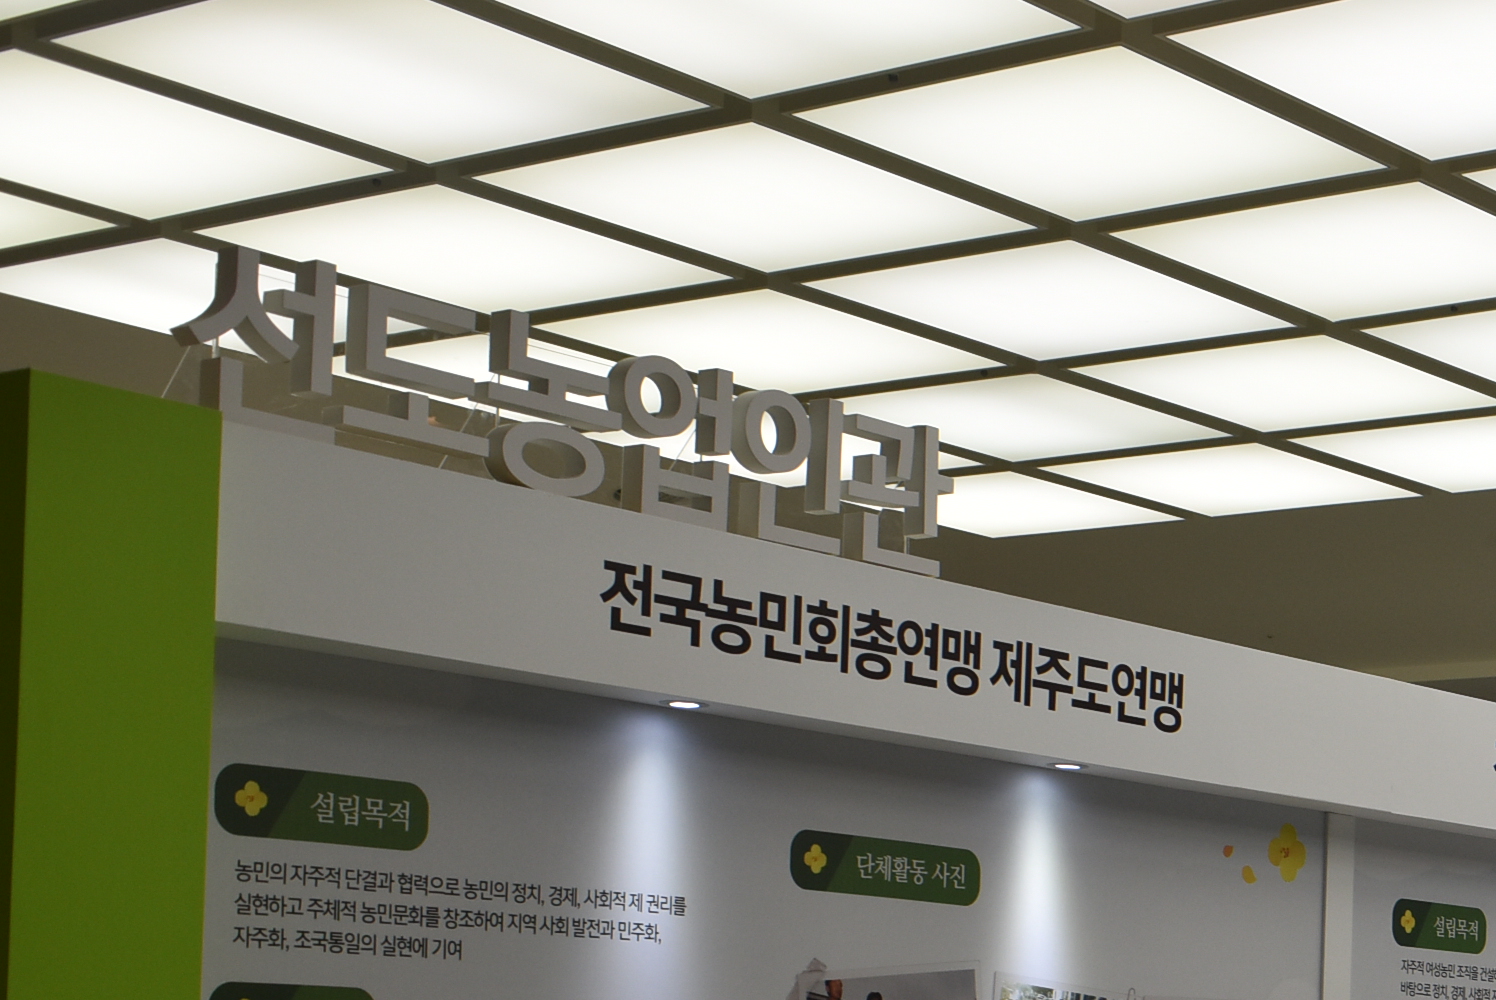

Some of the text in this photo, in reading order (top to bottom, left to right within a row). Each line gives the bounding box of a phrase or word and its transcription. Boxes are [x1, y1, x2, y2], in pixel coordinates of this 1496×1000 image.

[172, 245, 952, 576] 선도농업인관
[599, 560, 1185, 733] 전국농민회총연맹 제주도연맹
[310, 792, 410, 831] 설립목적
[234, 860, 288, 884] 농민의
[289, 865, 342, 889] 자주적
[344, 869, 396, 893] 단결과
[396, 873, 461, 896] 협력으로
[462, 879, 509, 902] 농민의
[583, 889, 627, 911] 사회적
[627, 893, 644, 912] 제
[645, 895, 688, 916] 권리를
[856, 853, 966, 889] 단체활동 사진
[234, 893, 305, 917] 실현하고
[306, 898, 357, 922] 주체적
[359, 902, 442, 928] 농민문화를
[442, 908, 504, 932] 창조하여
[506, 913, 537, 934] 지역
[538, 916, 570, 937] 사회
[571, 918, 616, 940] 발전과
[1433, 916, 1479, 941] 설립목적
[293, 930, 377, 955] 조국통일의
[380, 935, 429, 958] 실현에
[431, 939, 463, 960] 기여
[1400, 960, 1425, 975] 자주적
[1425, 962, 1456, 978] 여성농민
[1456, 965, 1480, 981] 조직을
